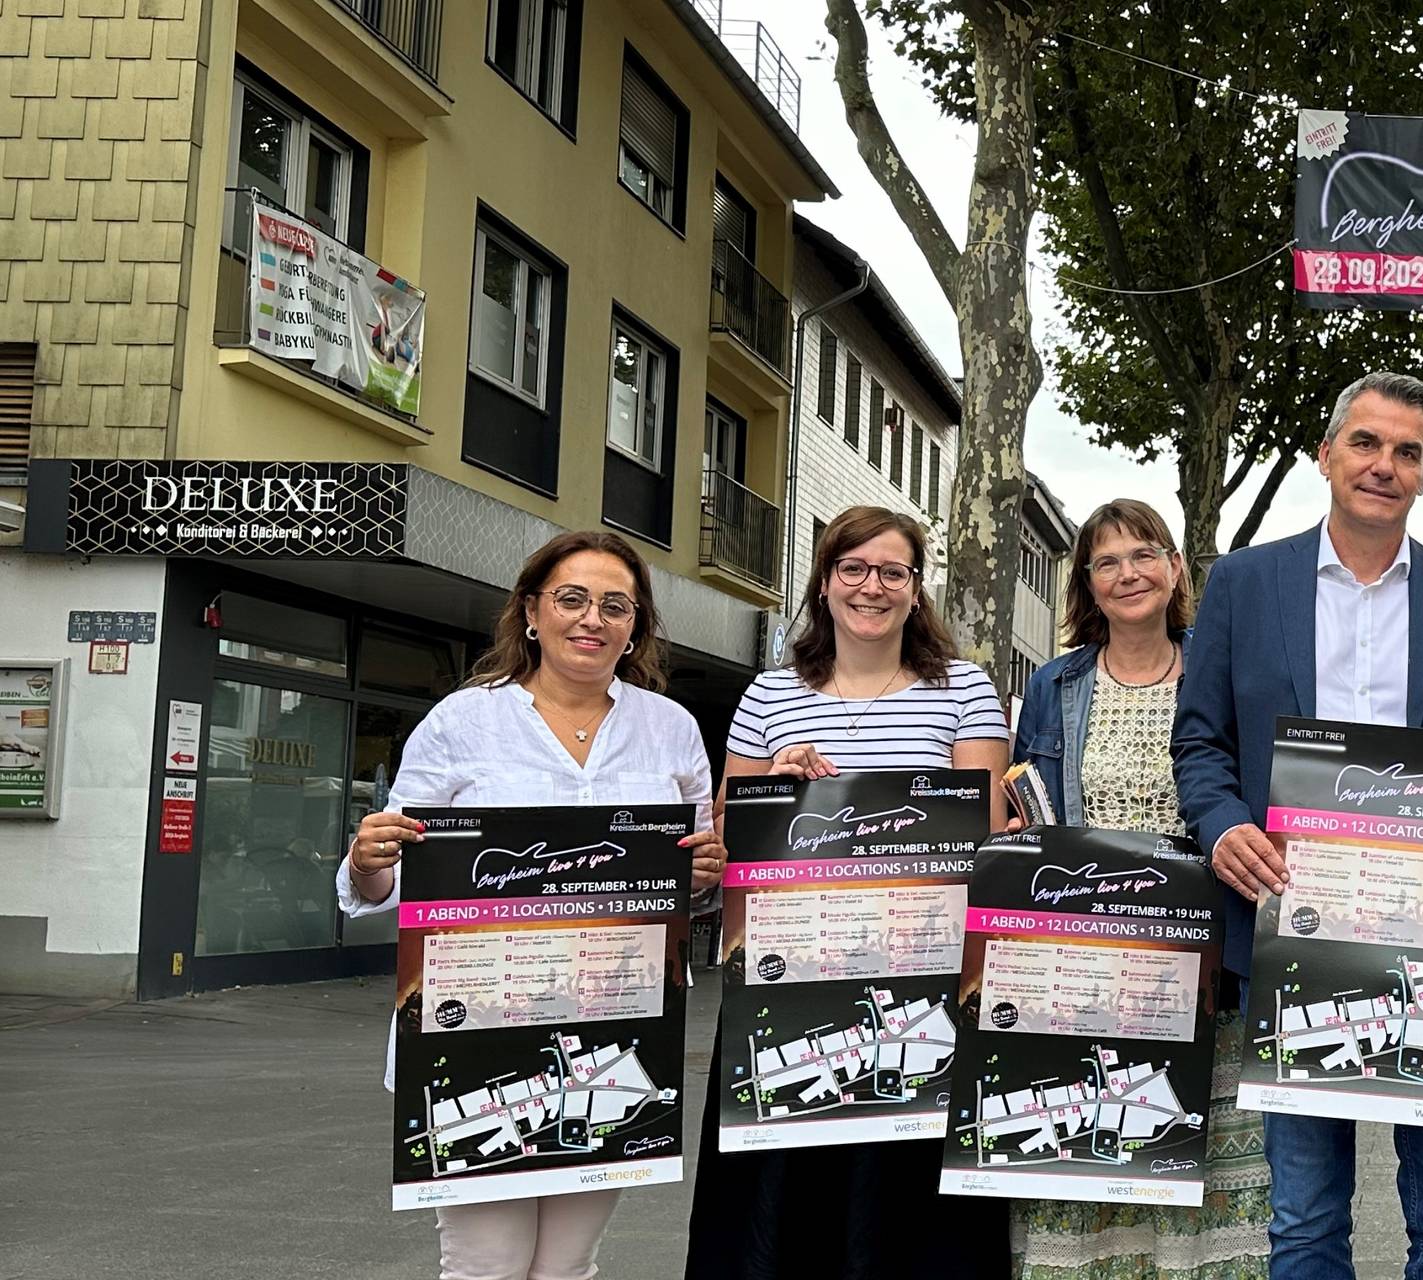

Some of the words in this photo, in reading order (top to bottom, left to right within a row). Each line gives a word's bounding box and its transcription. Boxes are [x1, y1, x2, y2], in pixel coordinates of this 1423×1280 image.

[1304, 121, 1338, 146] EINTRITT
[1315, 136, 1337, 151] FREI!
[142, 476, 337, 512] DELUXE
[177, 523, 235, 538] Konditorei
[239, 524, 248, 538] &
[251, 524, 302, 539] Bäckerei
[1287, 728, 1323, 740] EINTRITT
[737, 786, 772, 795] EINTRITT
[945, 788, 980, 797] Bergheim
[1339, 785, 1401, 805] Bergheim
[1398, 805, 1413, 816] 28.
[648, 823, 686, 832] Bergheim
[1282, 815, 1288, 826] 1
[1292, 816, 1339, 830] ABEND
[1351, 821, 1366, 833] 12
[793, 831, 852, 852] Bergheim
[856, 822, 879, 836] live
[882, 820, 891, 830] 4
[852, 846, 868, 855] 28.
[869, 843, 930, 855] SEPTEMBER
[937, 843, 949, 853] 19
[952, 842, 974, 852] UHR
[477, 867, 543, 890] Bergheim
[548, 859, 573, 874] live
[577, 857, 586, 868] 4
[738, 870, 744, 881] 1
[748, 867, 796, 879] ABEND
[808, 866, 823, 878] 12
[826, 864, 901, 877] LOCATIONS
[912, 862, 927, 873] 13
[932, 861, 974, 872] BANDS
[542, 883, 559, 894] 28.
[561, 881, 627, 893] SEPTEMBER
[637, 880, 649, 891] 19
[651, 880, 677, 890] UHR
[1034, 886, 1094, 904] Bergheim
[1097, 880, 1119, 893] live
[1123, 879, 1132, 888] 4
[416, 909, 422, 921] 1
[427, 907, 479, 920] ABEND
[492, 905, 509, 918] 12
[513, 903, 595, 917] LOCATIONS
[608, 901, 623, 912] 13
[626, 899, 675, 912] BANDS
[1091, 903, 1106, 914] 28.
[1109, 904, 1166, 917] SEPTEMBER
[1175, 908, 1187, 918] 19
[1189, 910, 1212, 920] UHR
[981, 915, 986, 926] 1
[990, 916, 1035, 929] ABEND
[1047, 919, 1061, 931] 12
[1064, 920, 1138, 936] LOCATIONS
[1148, 926, 1163, 937] 13
[1166, 927, 1210, 941] BANDS
[580, 1167, 652, 1184] westenergie
[1107, 1185, 1175, 1199] westenergie
